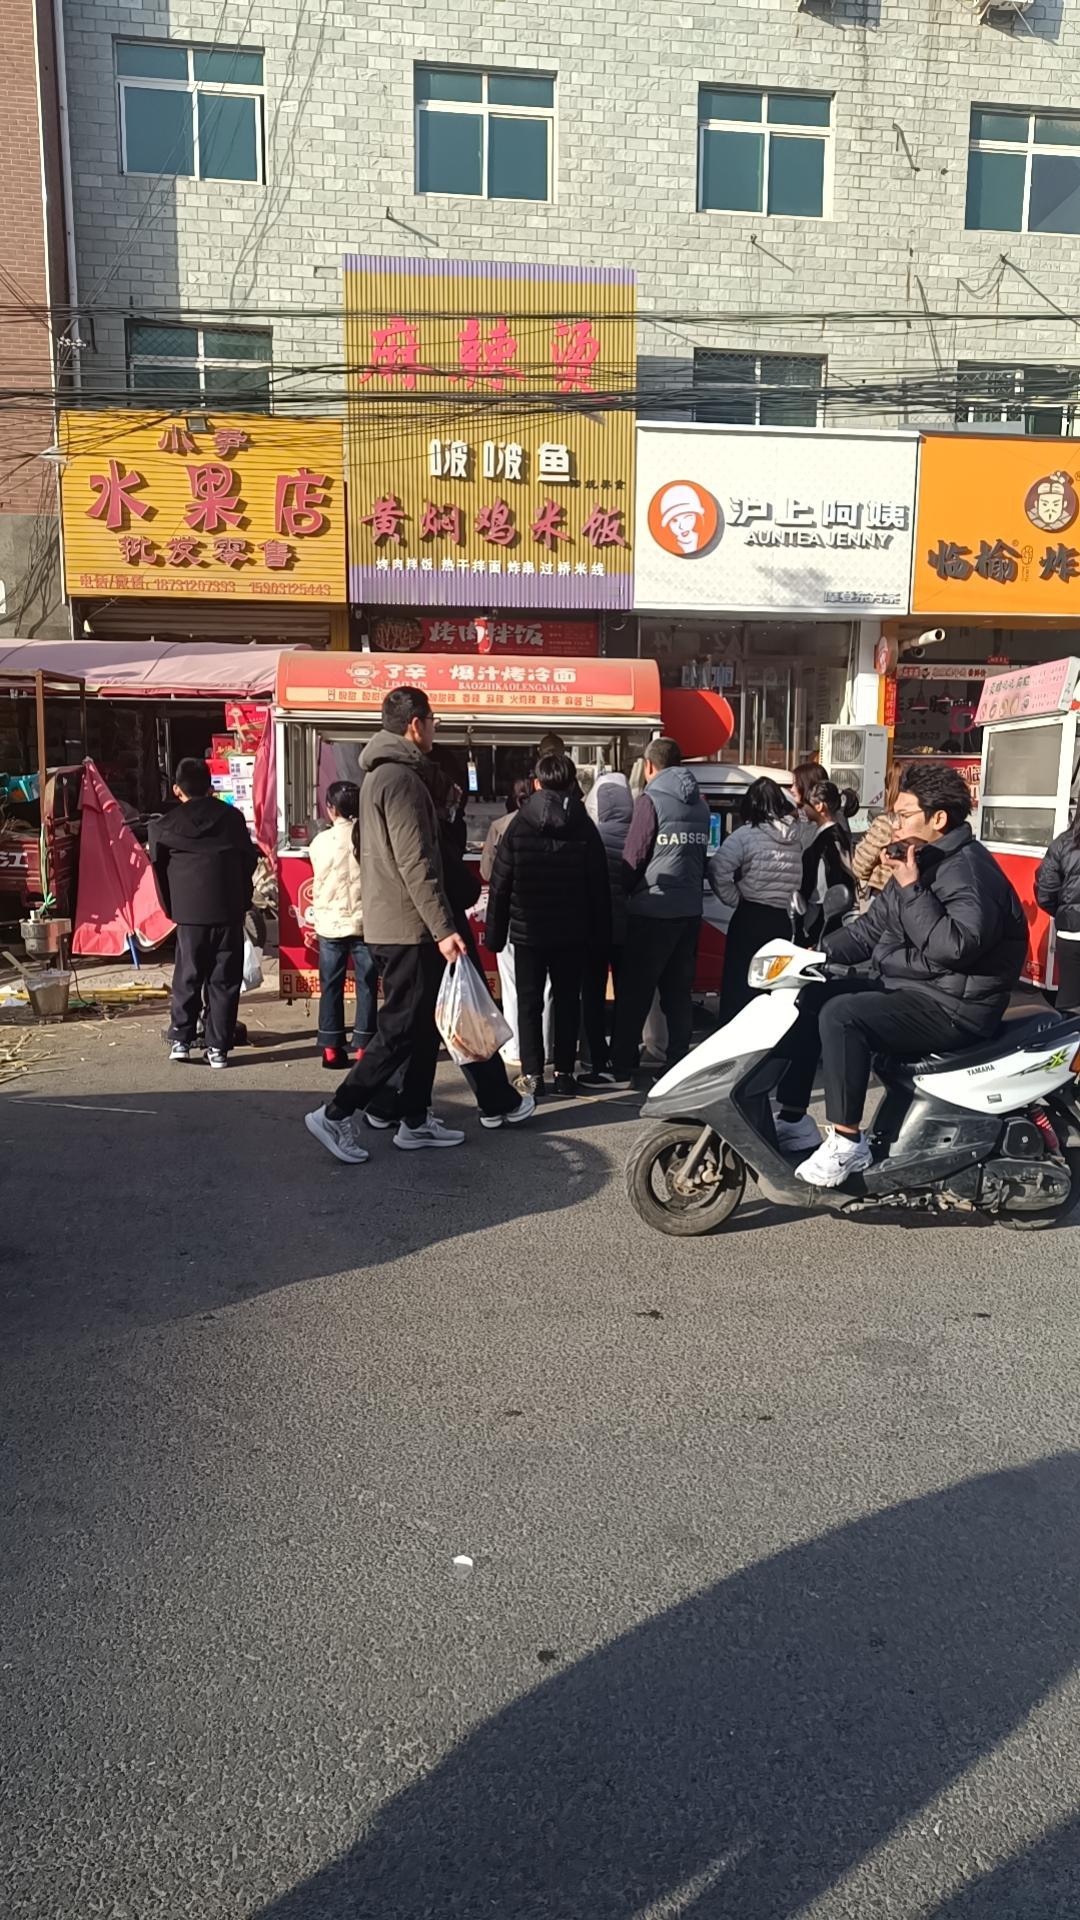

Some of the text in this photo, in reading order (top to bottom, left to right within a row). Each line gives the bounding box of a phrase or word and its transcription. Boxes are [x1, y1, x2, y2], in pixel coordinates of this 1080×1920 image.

[359, 315, 606, 398] 麻辣烫
[429, 438, 572, 483] 啵啵鱼
[85, 459, 328, 536] 水果店
[728, 496, 908, 530] 沪上阿姨
[359, 492, 626, 550] 黄焖鸡米饭
[118, 536, 293, 568] 批发零售
[745, 530, 893, 549] AUNTEA JENNY
[375, 557, 606, 577] 烤肉拌饭 热干拌面 炸串 过桥米线
[428, 621, 545, 646] 烤肉拌饭
[449, 664, 577, 683] 爆汁烤冷面
[966, 1064, 996, 1077] YAMAHA
